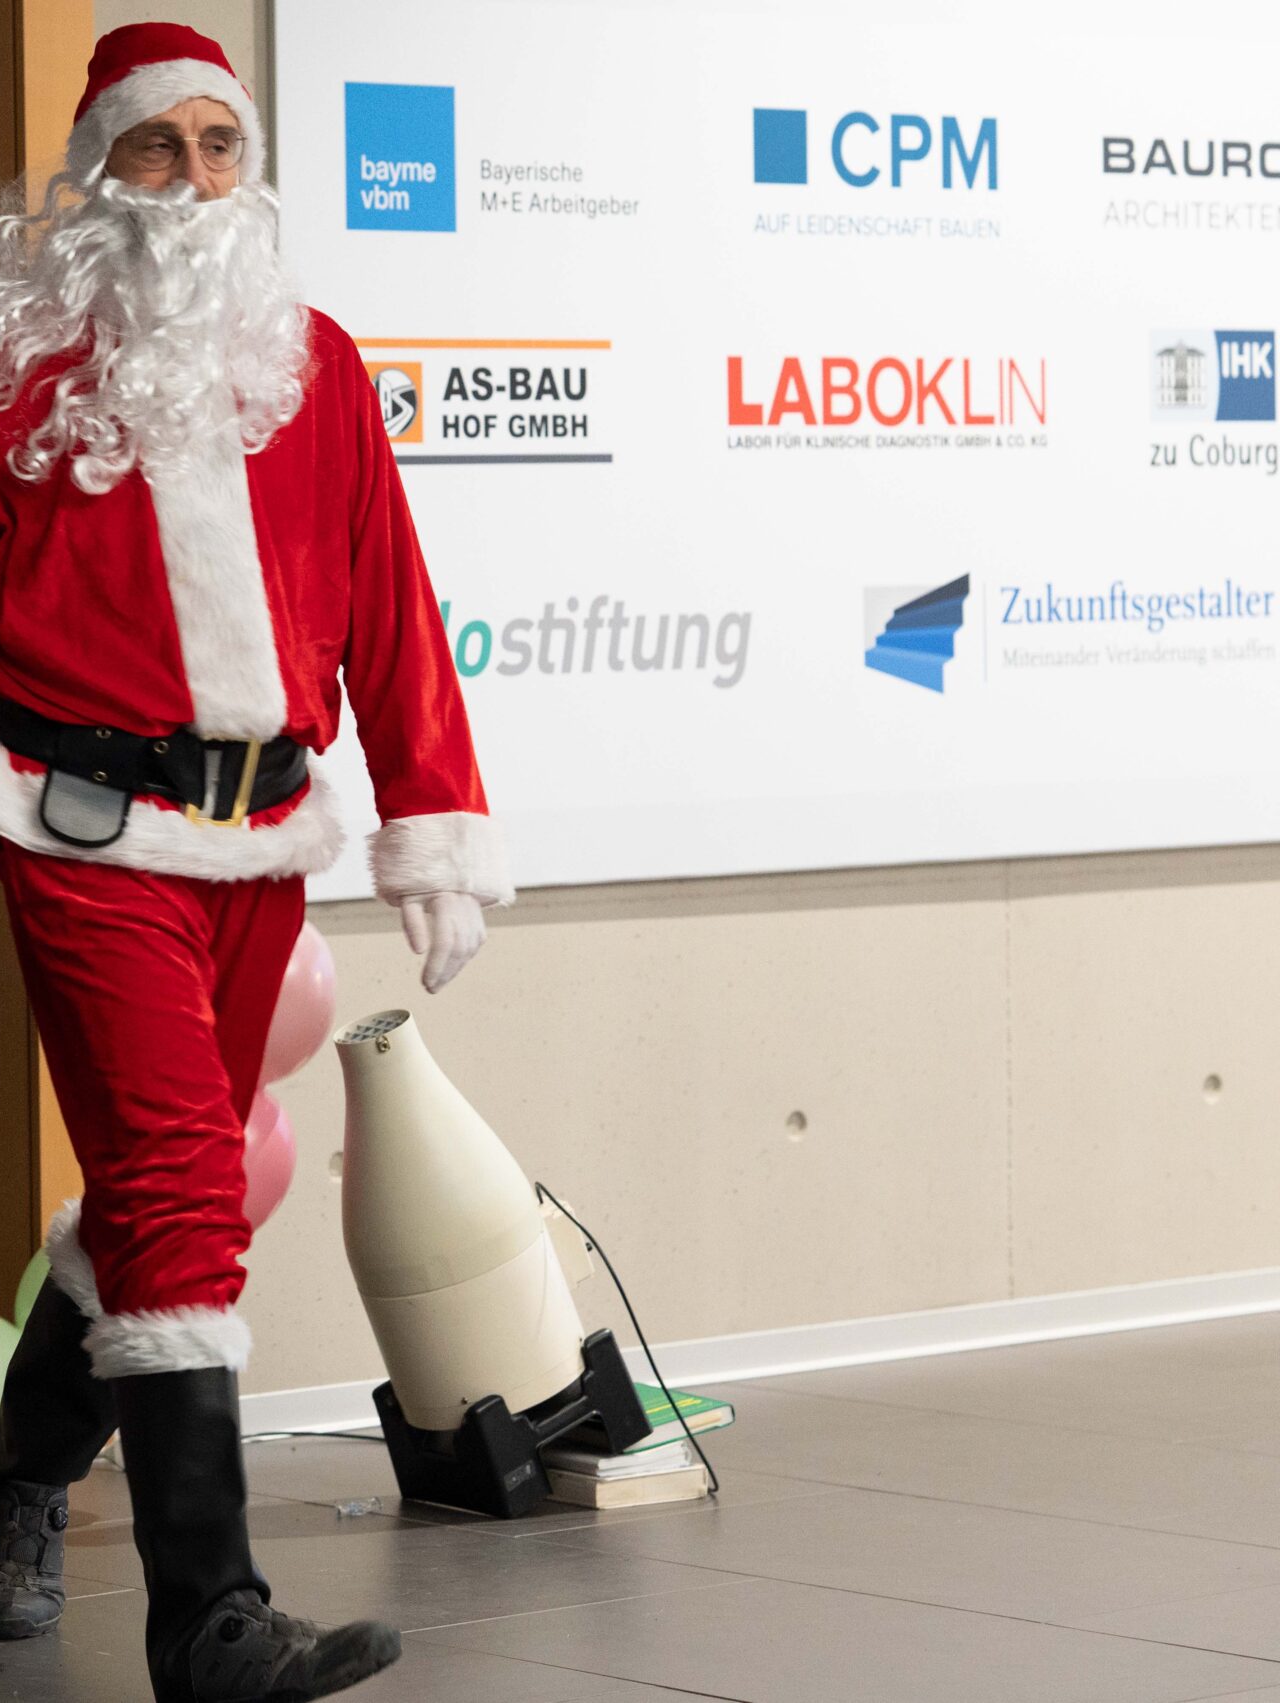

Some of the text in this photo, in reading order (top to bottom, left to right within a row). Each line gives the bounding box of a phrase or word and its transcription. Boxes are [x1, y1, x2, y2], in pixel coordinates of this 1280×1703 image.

[831, 111, 998, 190] CPM
[361, 155, 436, 187] bayme
[480, 159, 583, 184] Bayerische
[361, 186, 409, 210] vbm
[480, 191, 639, 218] M+E Arbeitgeber
[754, 213, 1001, 238] AUF LEIDENSCHAFT BAUEN
[1104, 200, 1280, 231] ARCHITEKTE
[1221, 341, 1272, 379] IHK
[443, 367, 587, 401] AS-BAU
[727, 356, 1046, 426] LABOKLIN
[442, 414, 588, 438] HOF GMBH
[727, 435, 772, 449] LABOR
[1150, 433, 1278, 476] zu Coburg
[1000, 578, 1275, 633] Zukunftsgestalter
